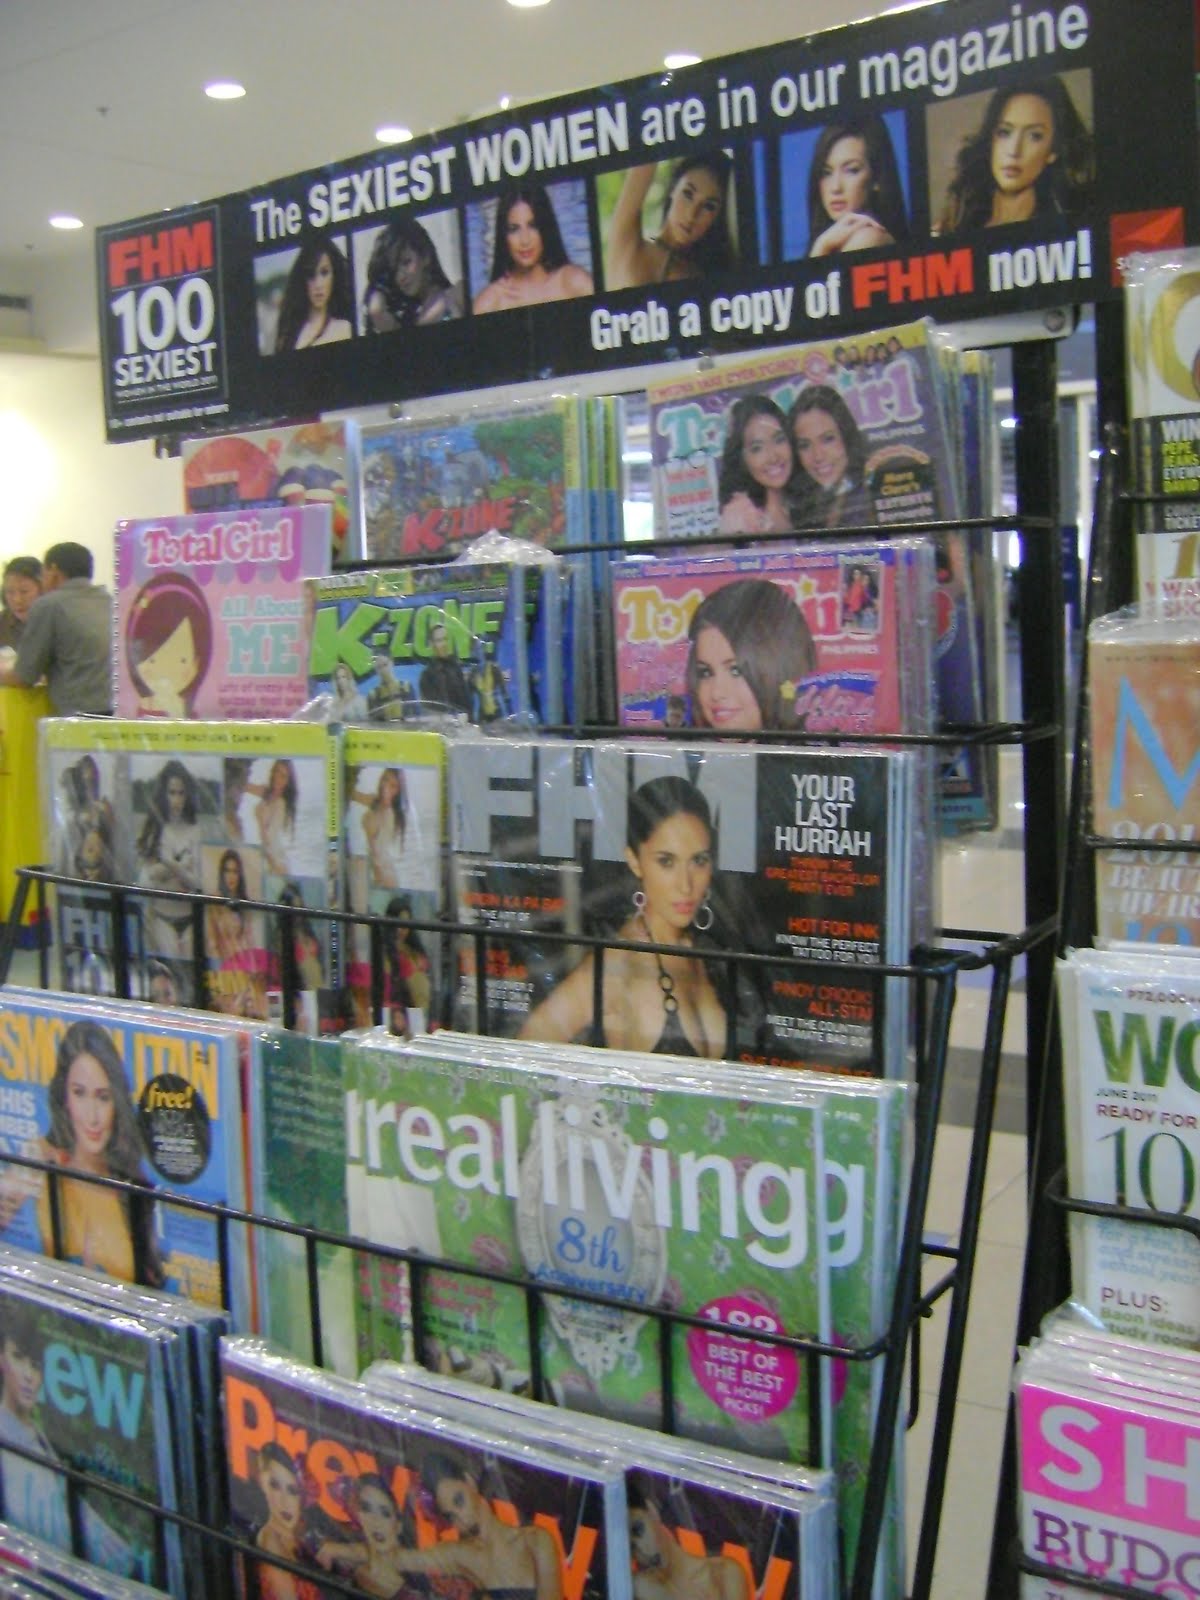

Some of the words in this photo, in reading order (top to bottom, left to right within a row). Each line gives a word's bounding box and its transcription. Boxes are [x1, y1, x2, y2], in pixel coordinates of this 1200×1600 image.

[251, 198, 302, 243] The
[308, 149, 456, 228] SEXIEST
[465, 101, 630, 187] WOMEN
[640, 97, 707, 147] are
[717, 77, 758, 131] in
[770, 61, 846, 118] our
[858, 3, 1090, 98] magazine
[107, 219, 214, 289] FHM
[590, 300, 670, 351] Grab
[678, 302, 702, 339] a
[709, 286, 795, 335] copy
[804, 270, 842, 319] of
[851, 247, 975, 309] FHM
[988, 229, 1092, 293] now!
[111, 277, 216, 355] 100
[114, 341, 218, 388] SEXIEST
[227, 622, 300, 677] ME
[791, 773, 856, 802] YOUR
[795, 800, 853, 828] LAST
[774, 825, 872, 857] HURRAH
[788, 917, 818, 935] HOT
[144, 1081, 195, 1113] free!
[1095, 1103, 1155, 1125] READY
[1159, 1111, 1198, 1130] FOR
[365, 1093, 521, 1199] real
[540, 1097, 810, 1269] living
[556, 1216, 625, 1273] 8th
[1101, 1286, 1170, 1314] PLUS:
[1103, 1321, 1149, 1342] tudy
[707, 1343, 750, 1367] BEST
[752, 1352, 779, 1372] OF
[39, 1341, 146, 1440] ew
[704, 1360, 738, 1382] THE
[741, 1368, 785, 1392] BEST
